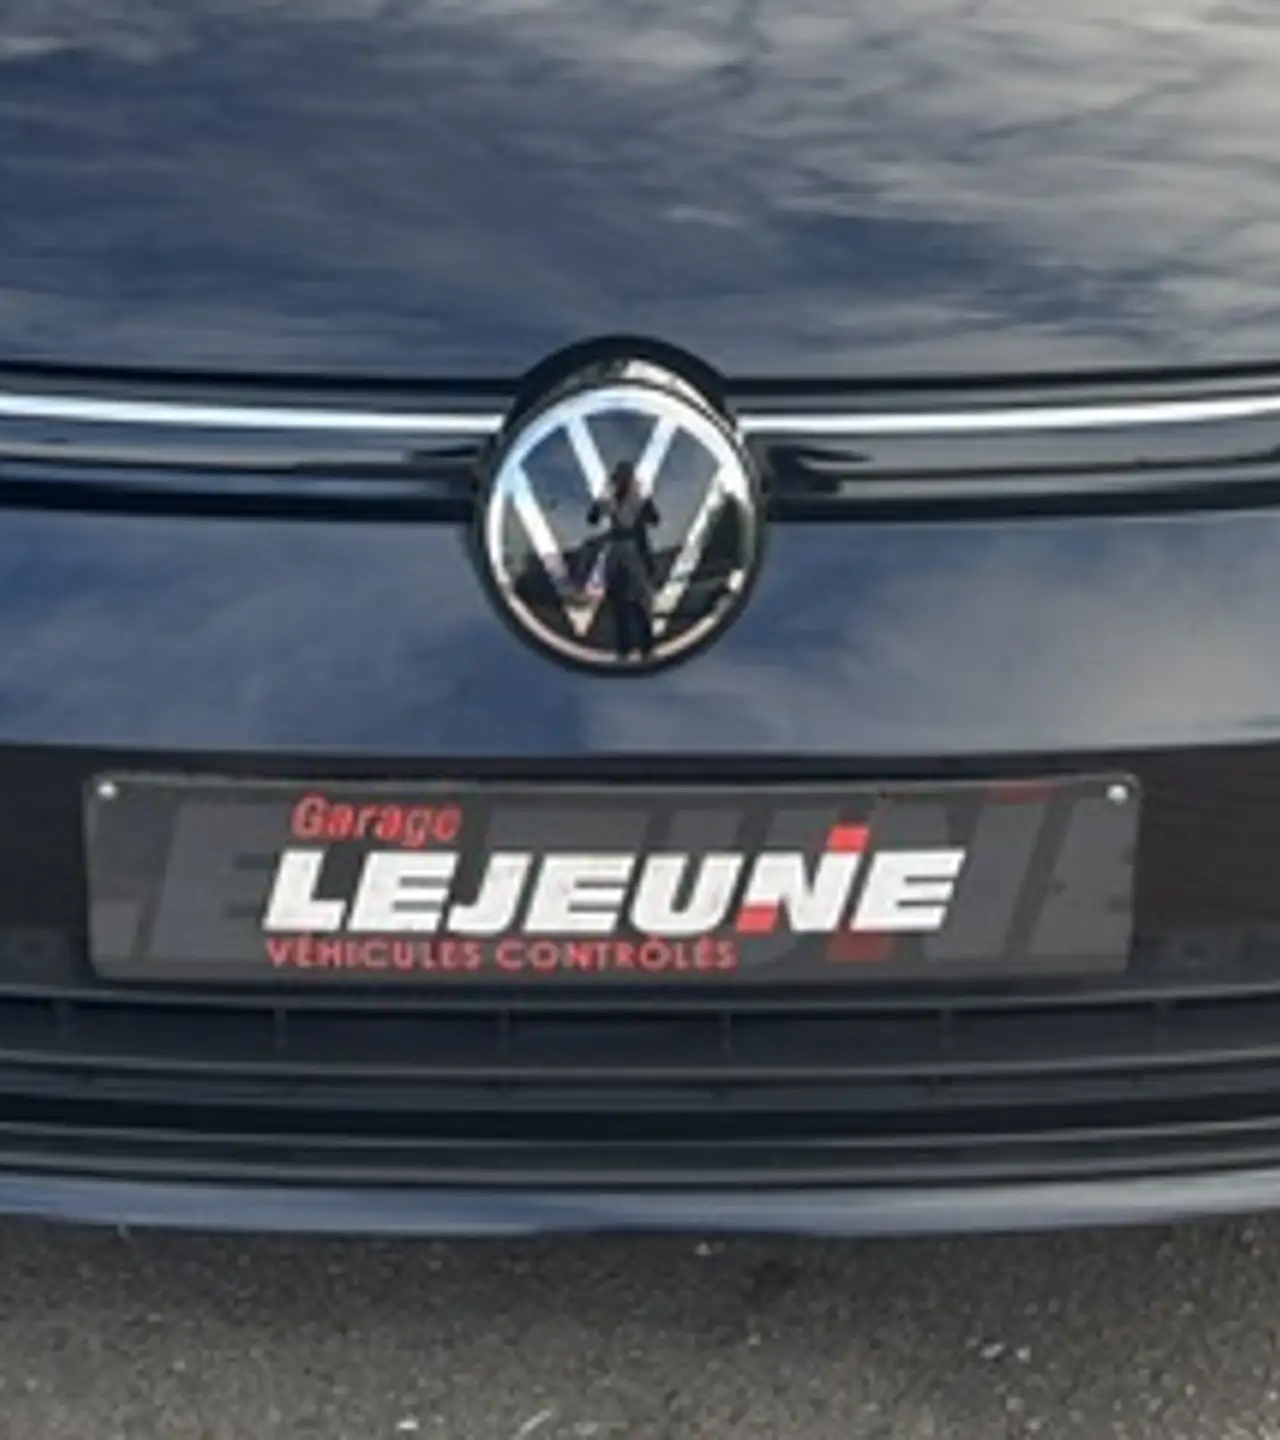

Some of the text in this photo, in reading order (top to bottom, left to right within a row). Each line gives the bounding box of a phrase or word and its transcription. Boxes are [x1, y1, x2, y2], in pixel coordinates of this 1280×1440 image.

[290, 794, 462, 848] Garage
[263, 826, 966, 934] LEJEUNE
[265, 932, 738, 971] VÉHICULES CONTRÔLÉS
